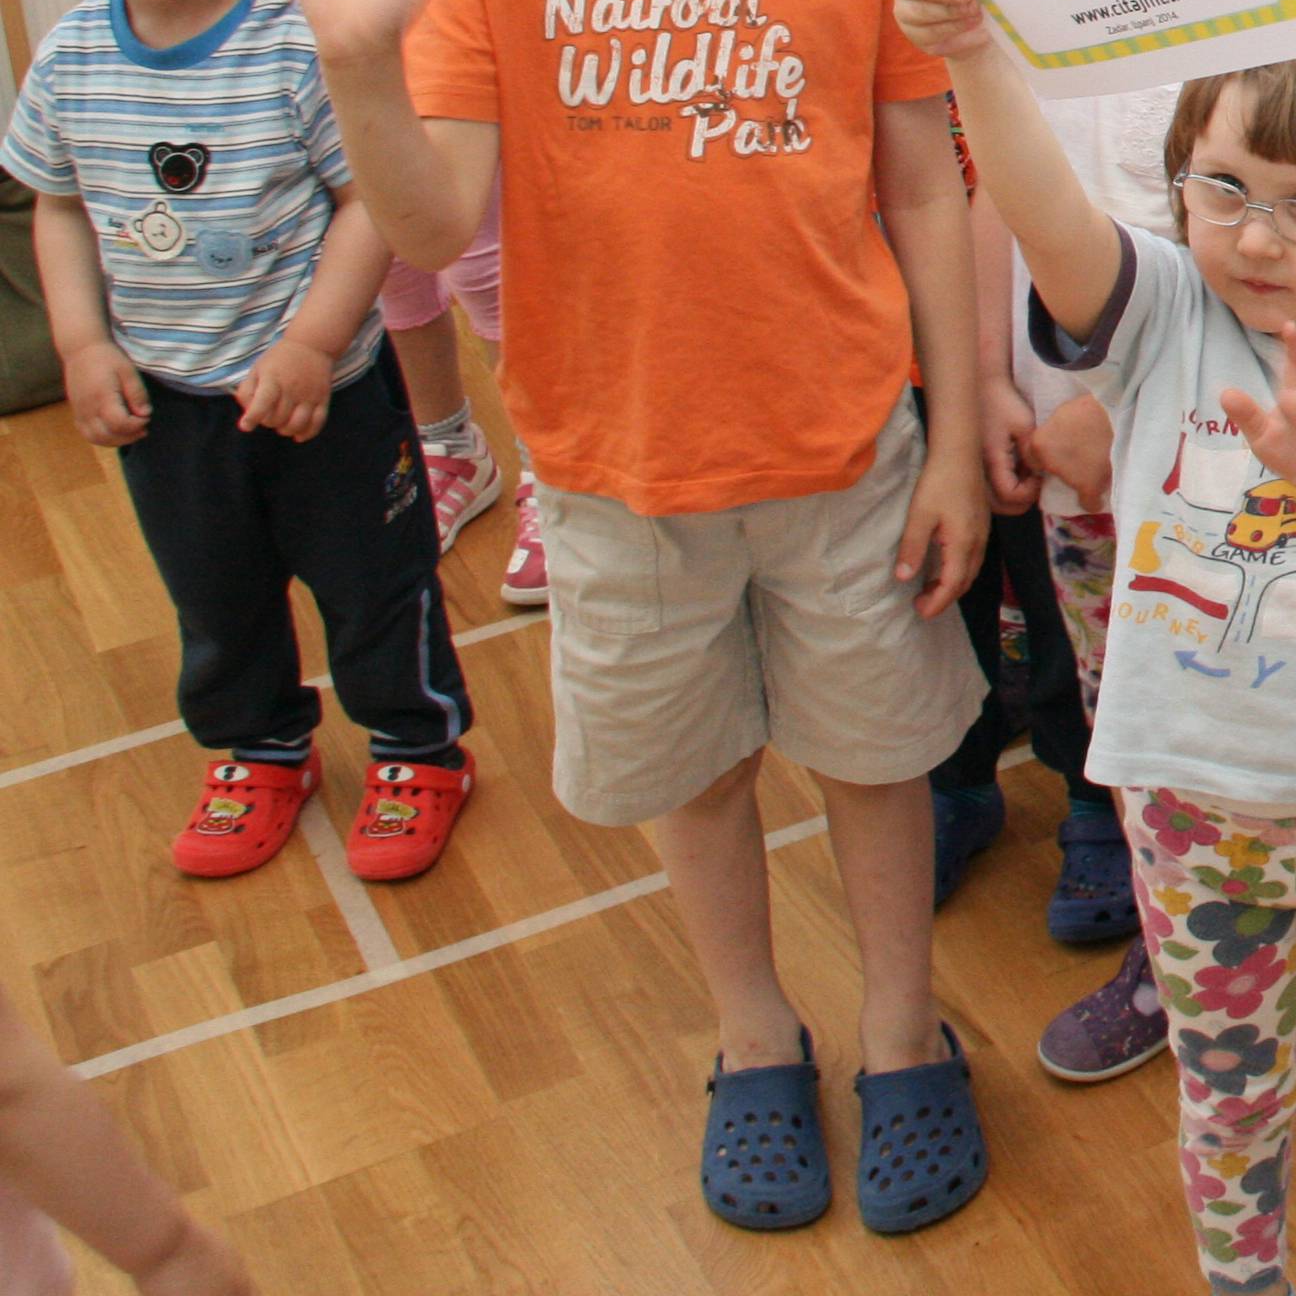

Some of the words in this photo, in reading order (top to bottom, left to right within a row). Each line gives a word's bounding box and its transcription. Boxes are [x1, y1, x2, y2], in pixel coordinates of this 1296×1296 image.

[558, 23, 806, 107] Wildlife
[568, 116, 602, 132] TOM
[612, 116, 672, 132] TAILOR
[680, 97, 812, 159] Park
[1211, 542, 1287, 565] GAME
